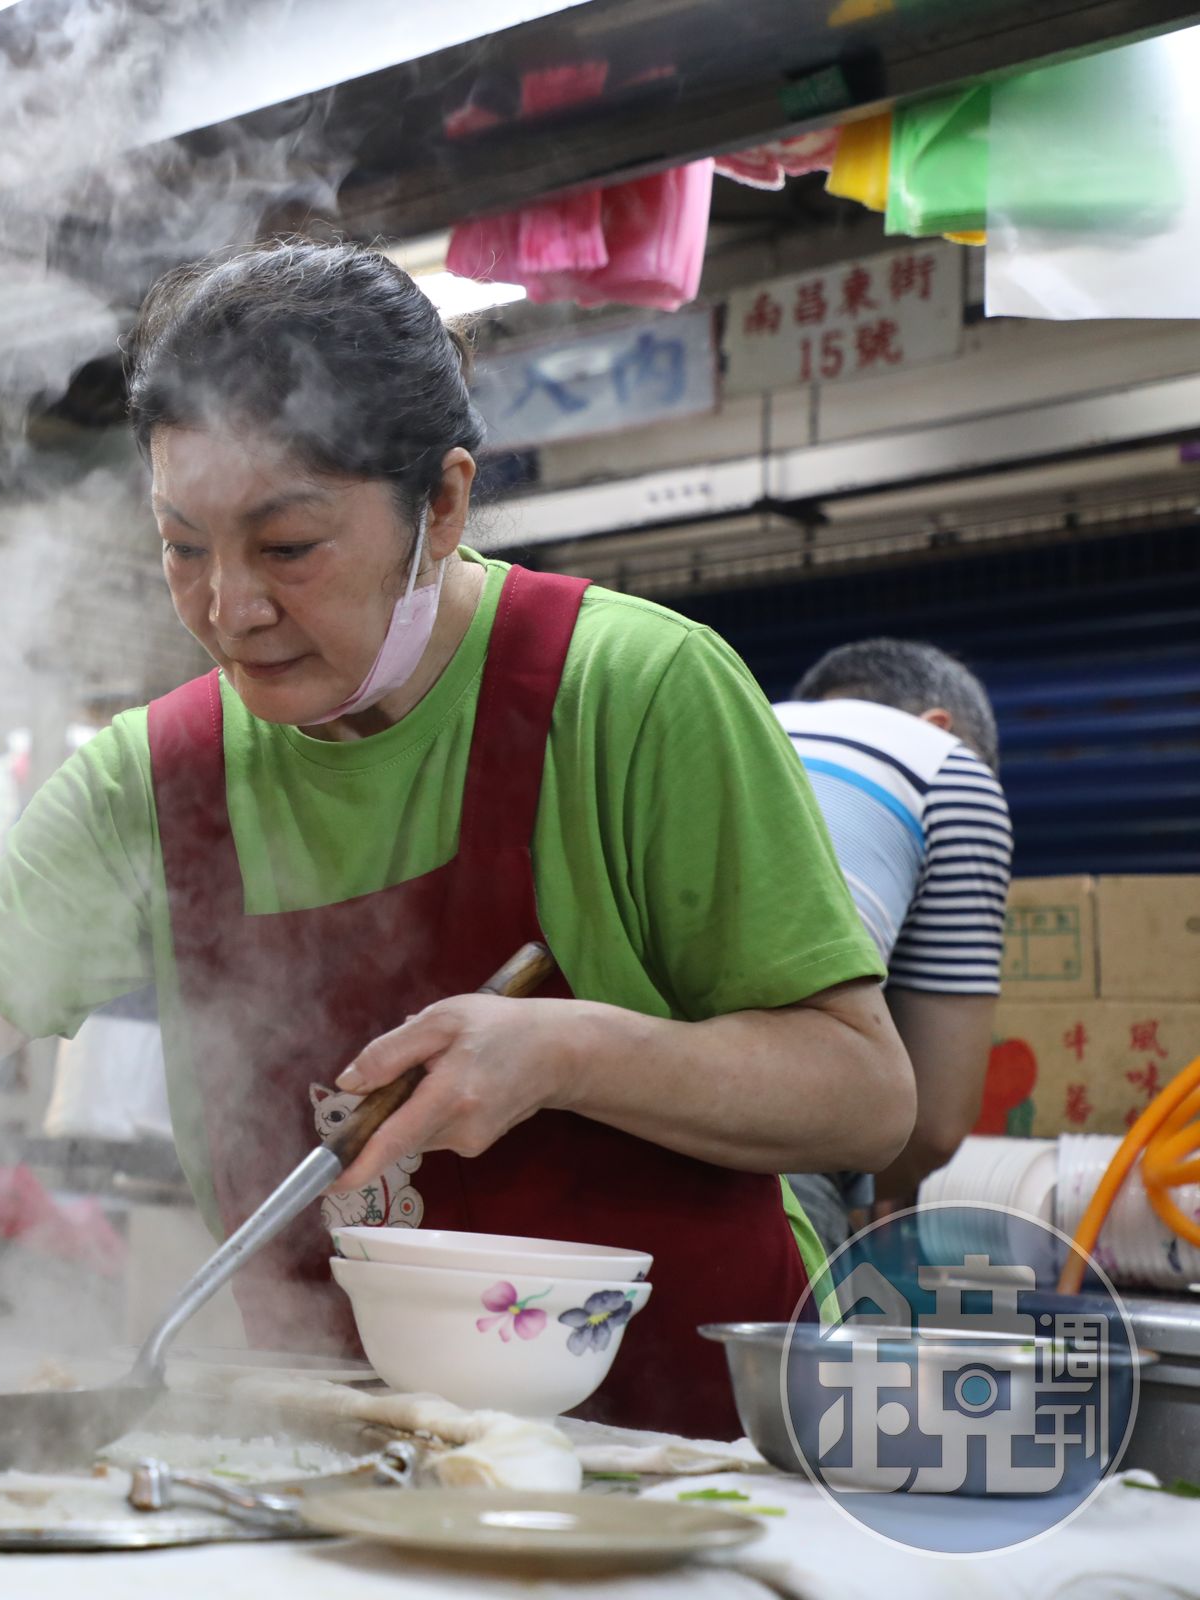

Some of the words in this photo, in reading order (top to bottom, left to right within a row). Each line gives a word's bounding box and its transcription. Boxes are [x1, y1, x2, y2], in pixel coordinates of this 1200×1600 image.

[743, 254, 935, 336] 南昌東街
[801, 317, 903, 382] 15號
